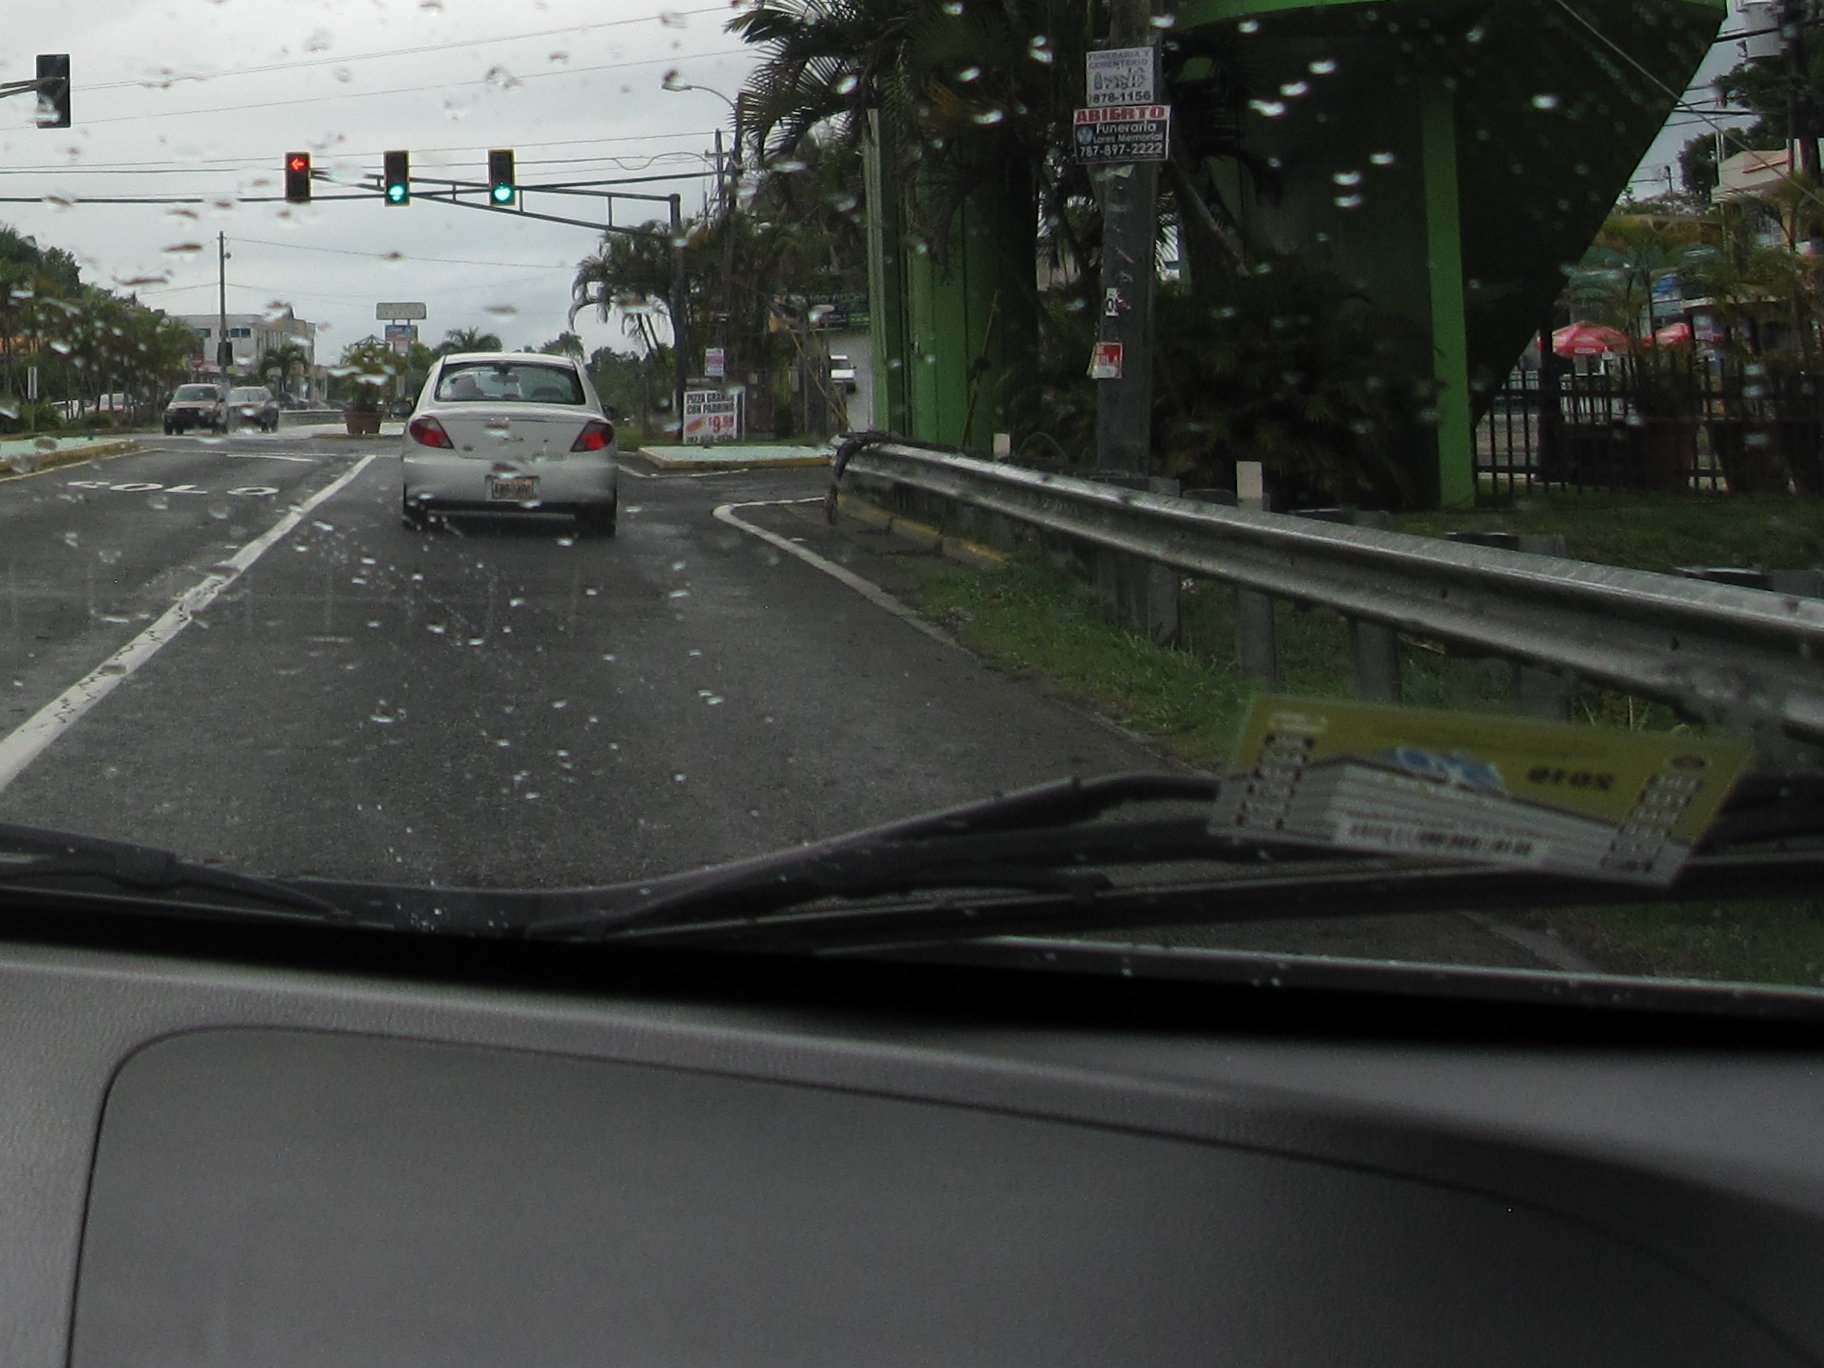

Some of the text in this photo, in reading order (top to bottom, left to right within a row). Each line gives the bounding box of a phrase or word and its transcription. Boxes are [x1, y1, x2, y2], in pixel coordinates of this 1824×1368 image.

[1076, 106, 1165, 123] ABIERTO
[1096, 120, 1156, 134] Funeraria
[1080, 143, 1163, 157] 787-897-2222
